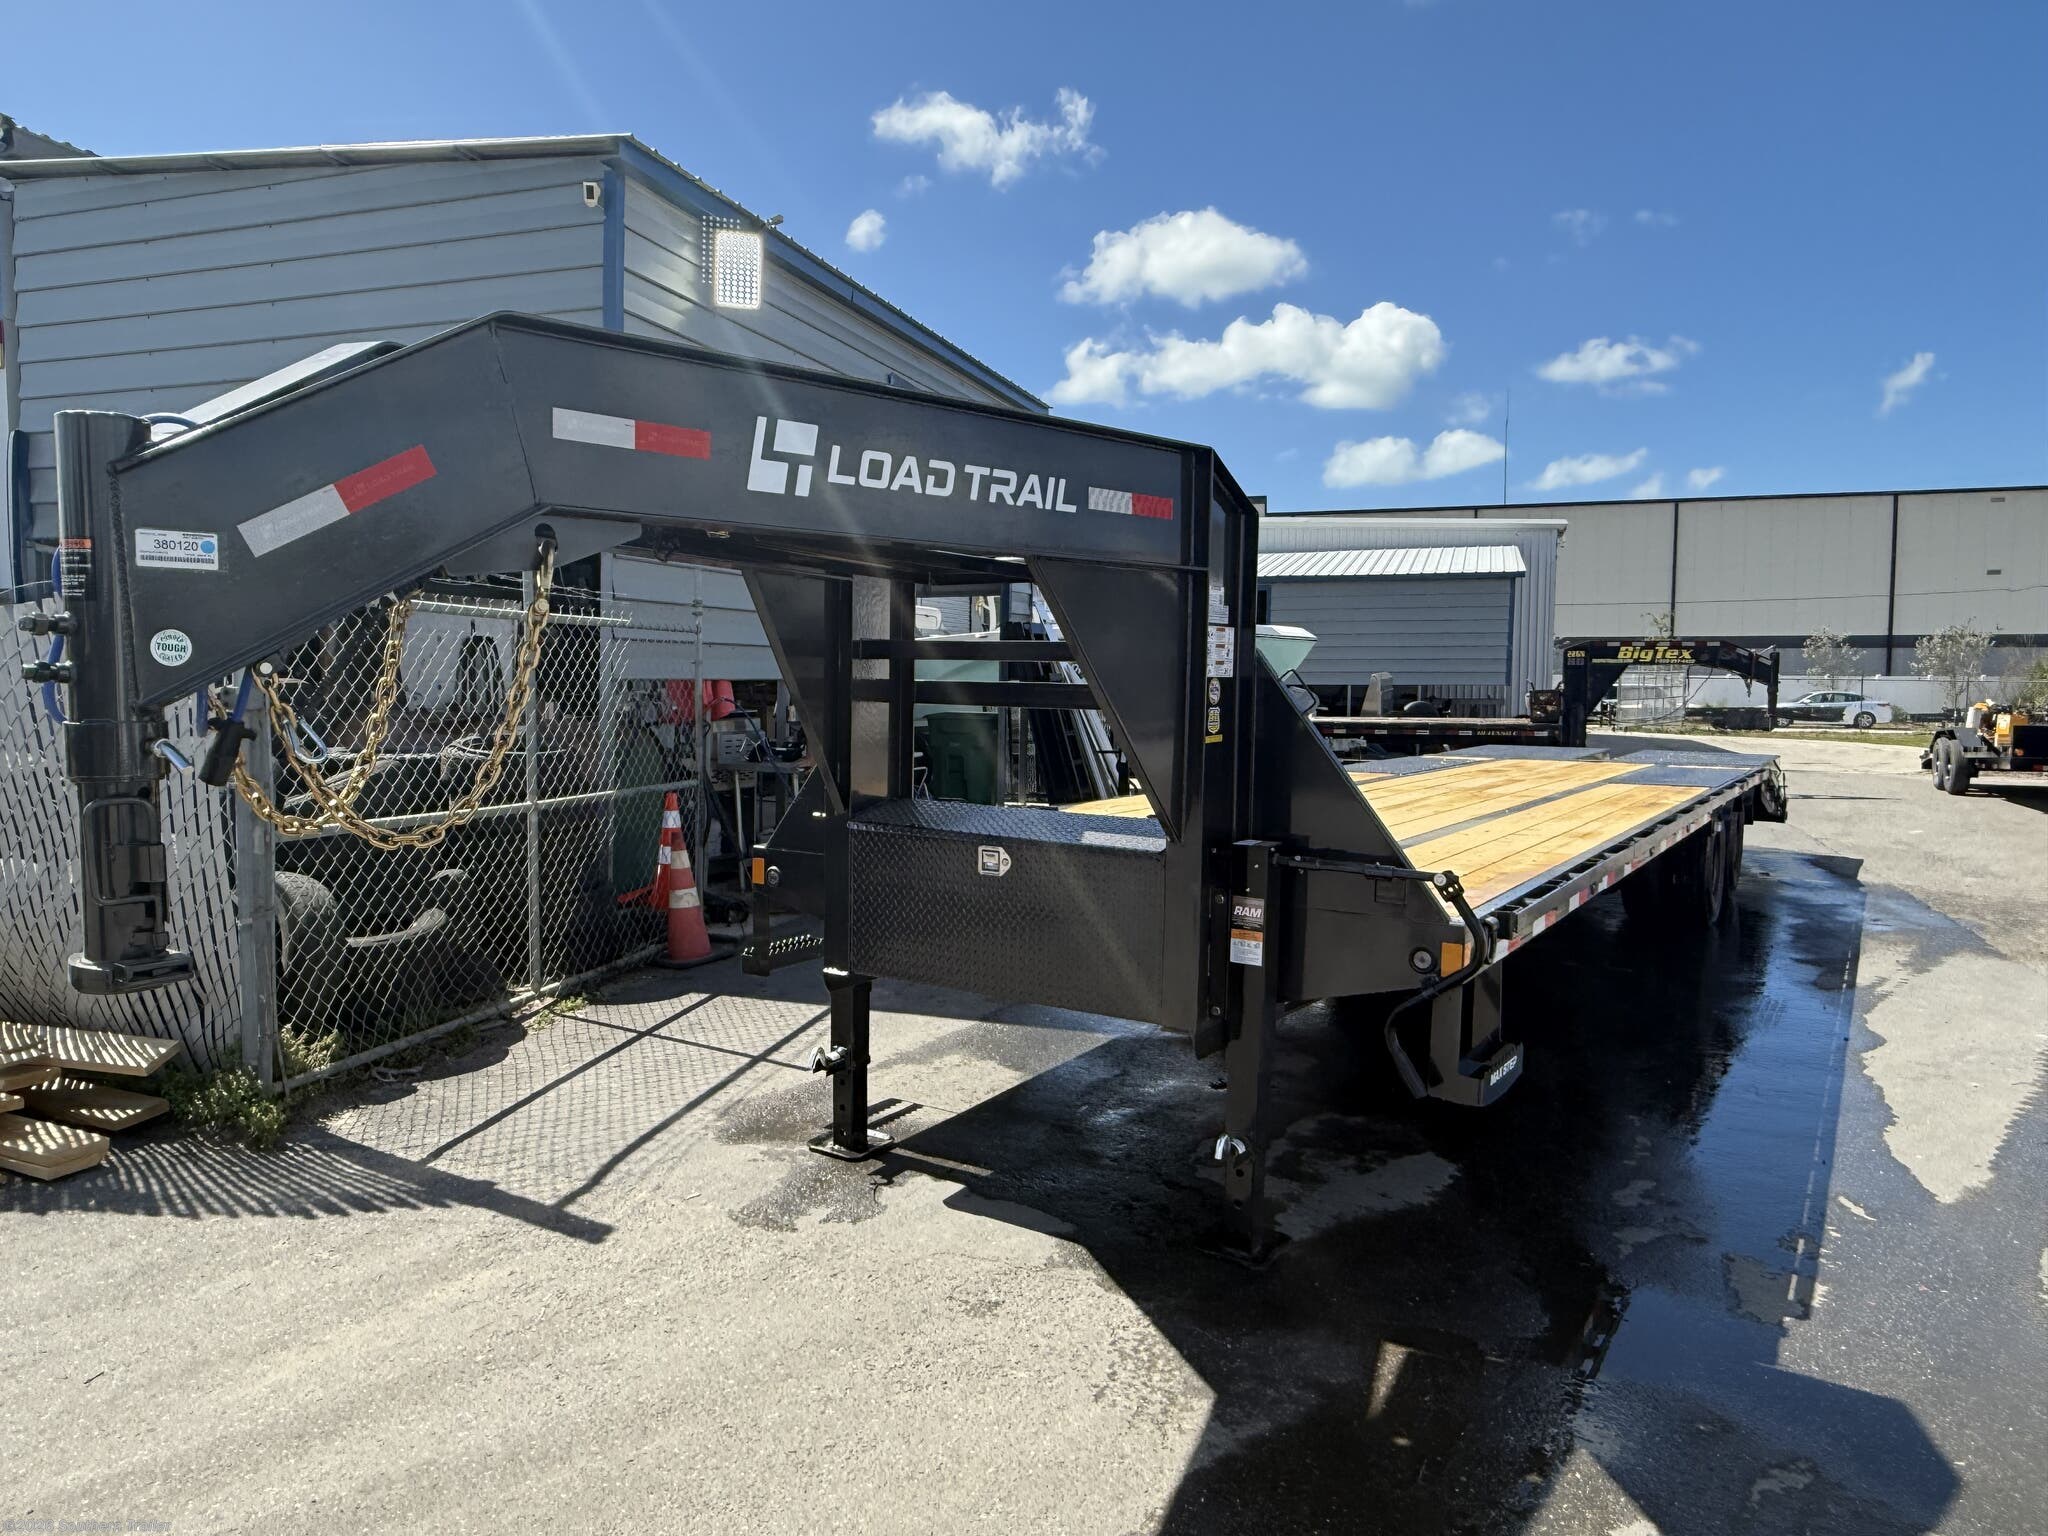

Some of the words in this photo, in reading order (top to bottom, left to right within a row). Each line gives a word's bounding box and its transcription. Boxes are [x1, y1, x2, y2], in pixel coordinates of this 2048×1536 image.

[828, 445, 955, 497] LOAD
[964, 464, 1076, 512] TRAIL
[153, 538, 199, 552] 380120
[156, 642, 186, 653] TOUGH
[1234, 905, 1262, 918] RAM
